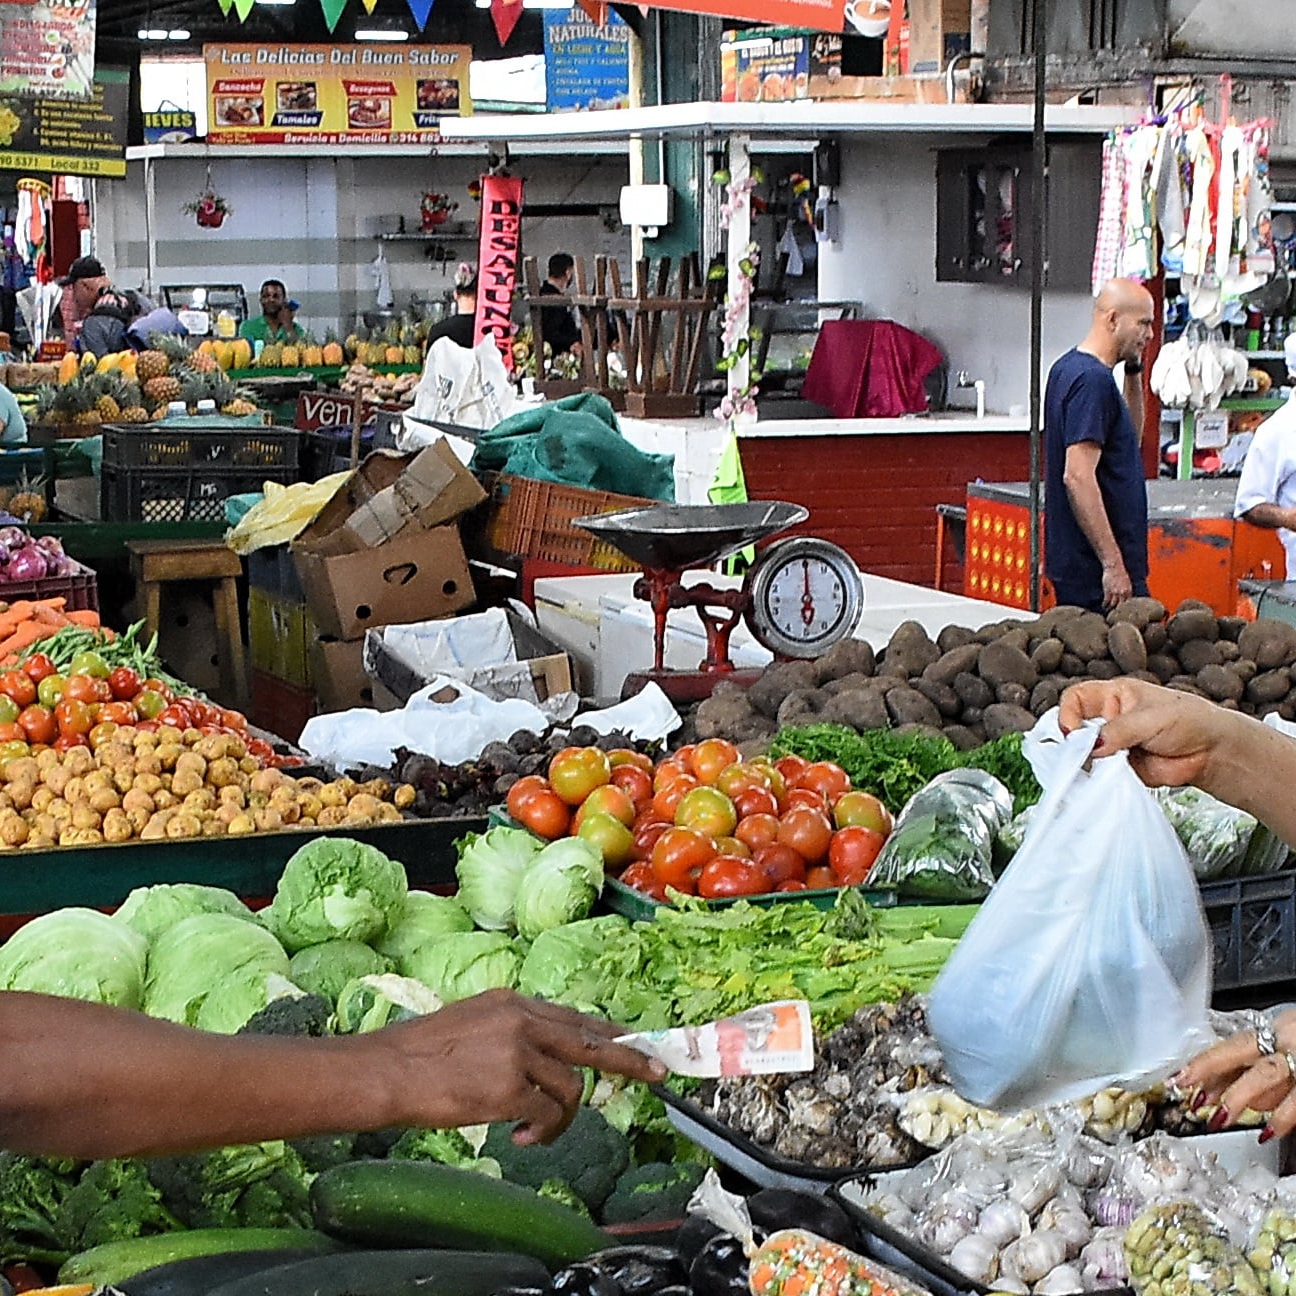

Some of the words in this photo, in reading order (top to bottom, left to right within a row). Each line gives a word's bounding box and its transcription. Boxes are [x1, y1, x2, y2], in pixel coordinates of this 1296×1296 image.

[549, 25, 628, 44] NATURALES
[221, 48, 251, 64] Las
[256, 47, 326, 65] Delicias
[330, 48, 356, 65] Del
[361, 49, 404, 65] Buen
[408, 48, 459, 65] Sabor
